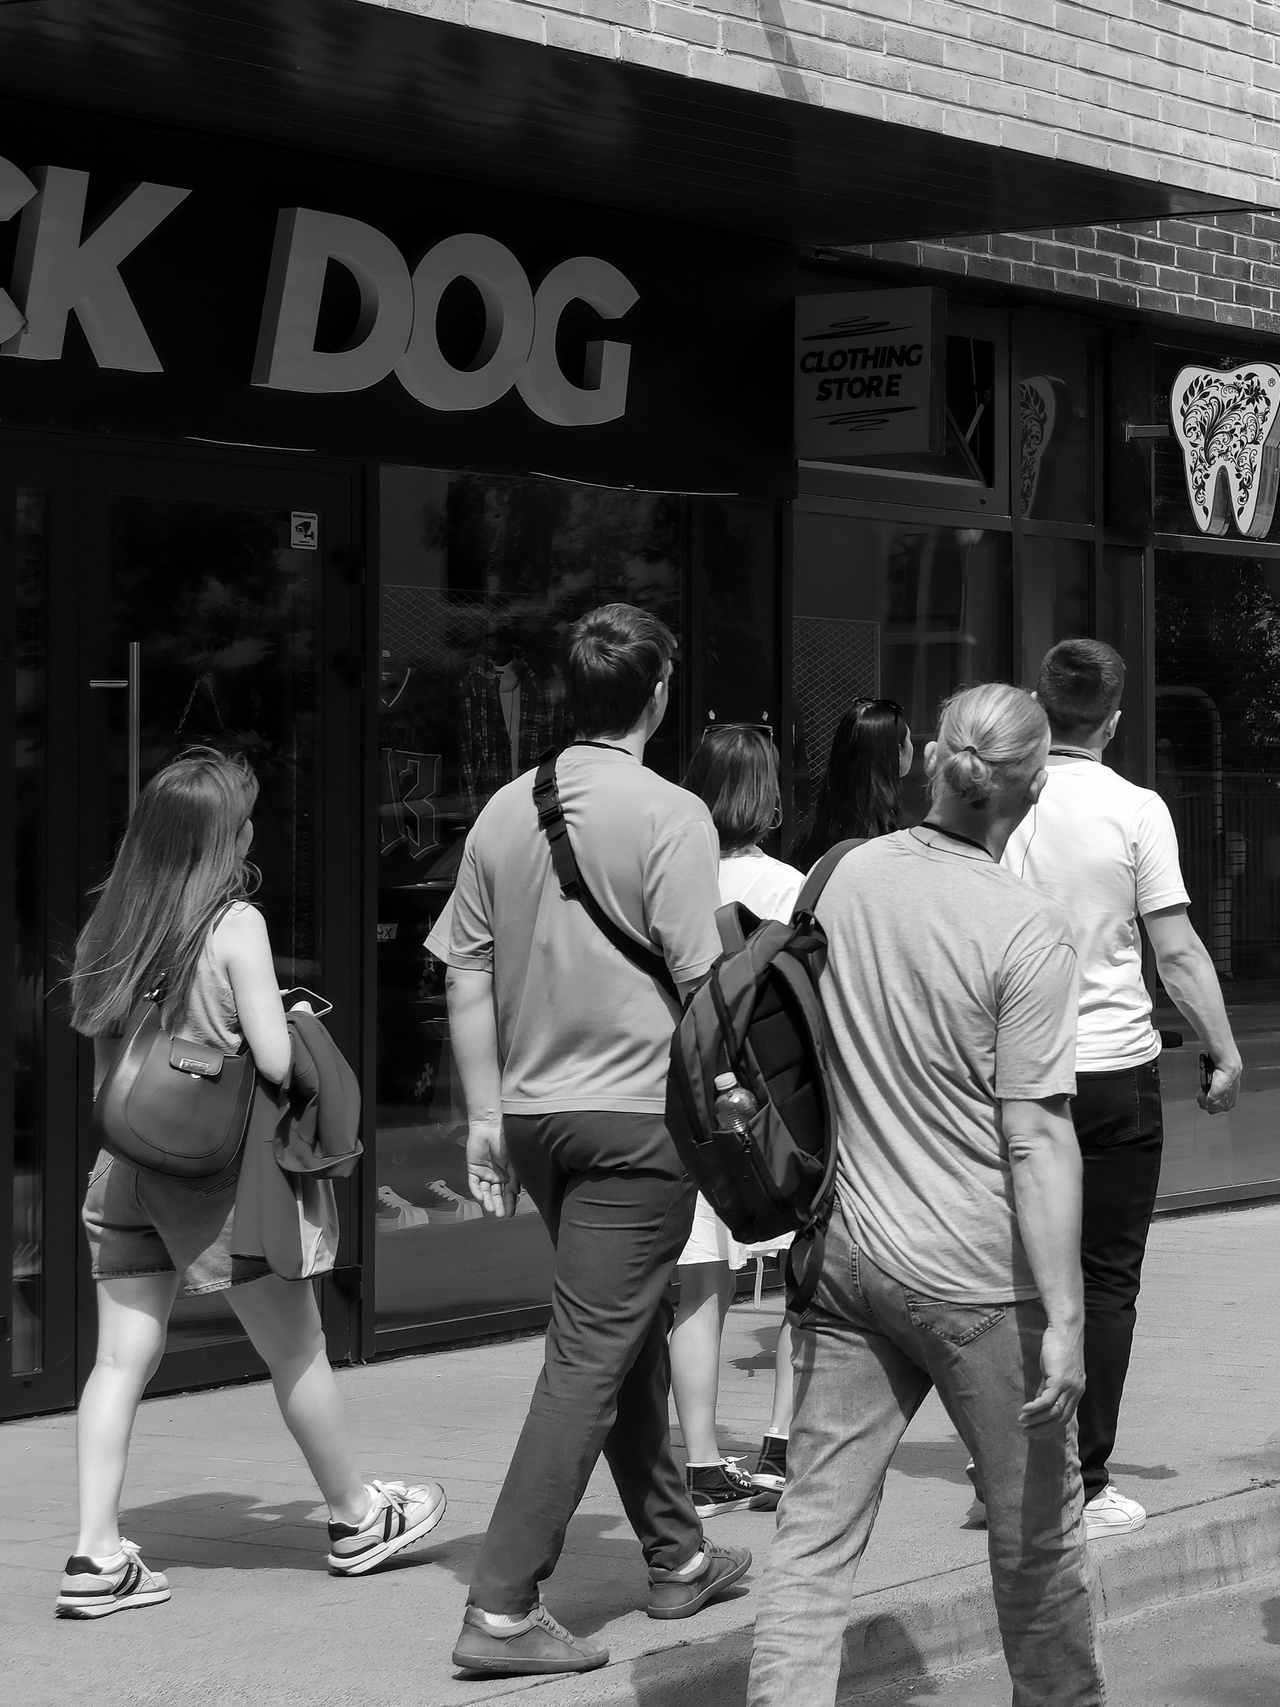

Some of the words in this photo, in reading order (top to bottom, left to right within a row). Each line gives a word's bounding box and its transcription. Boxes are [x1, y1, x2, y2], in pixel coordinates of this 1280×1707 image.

[251, 207, 640, 426] DOG
[800, 344, 923, 375] CLOTHING
[816, 373, 903, 402] STORE
